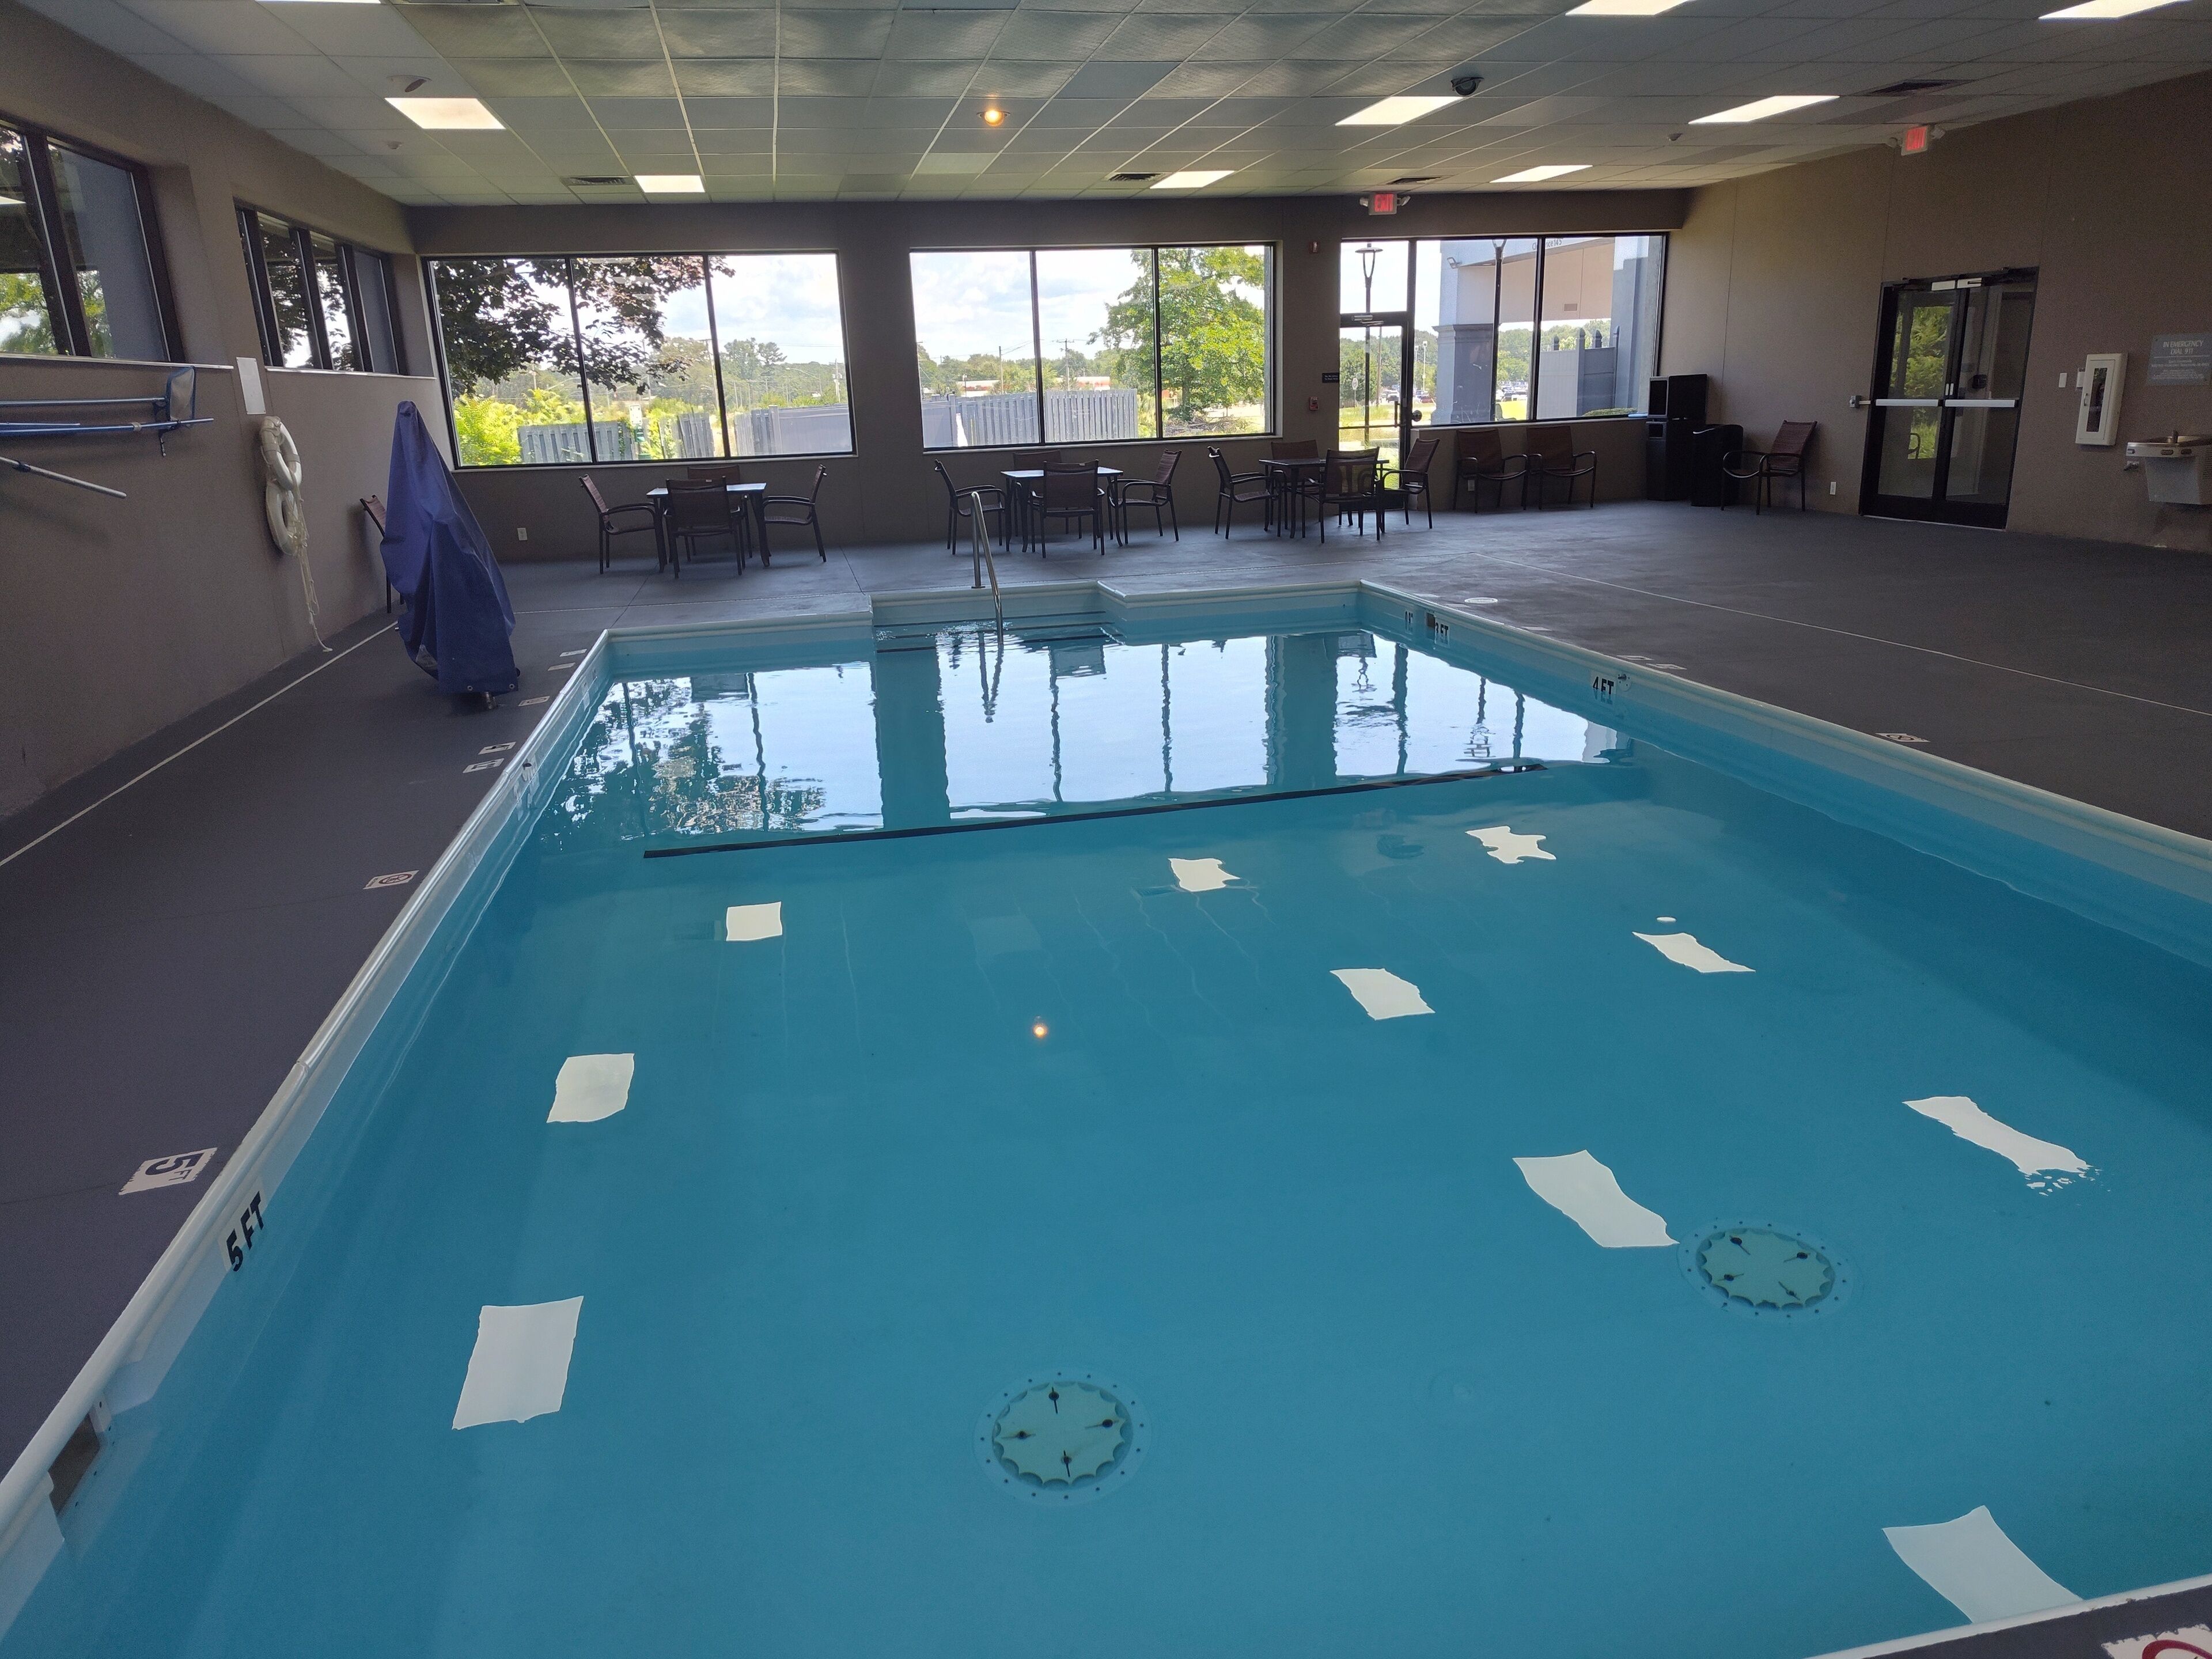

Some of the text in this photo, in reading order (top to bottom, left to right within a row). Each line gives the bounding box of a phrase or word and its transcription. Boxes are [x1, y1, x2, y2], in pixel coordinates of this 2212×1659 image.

[1593, 676, 1614, 695] 4 FT
[145, 1153, 204, 1176] 5
[168, 1169, 191, 1181] FT
[226, 1190, 264, 1272] 5 FT
